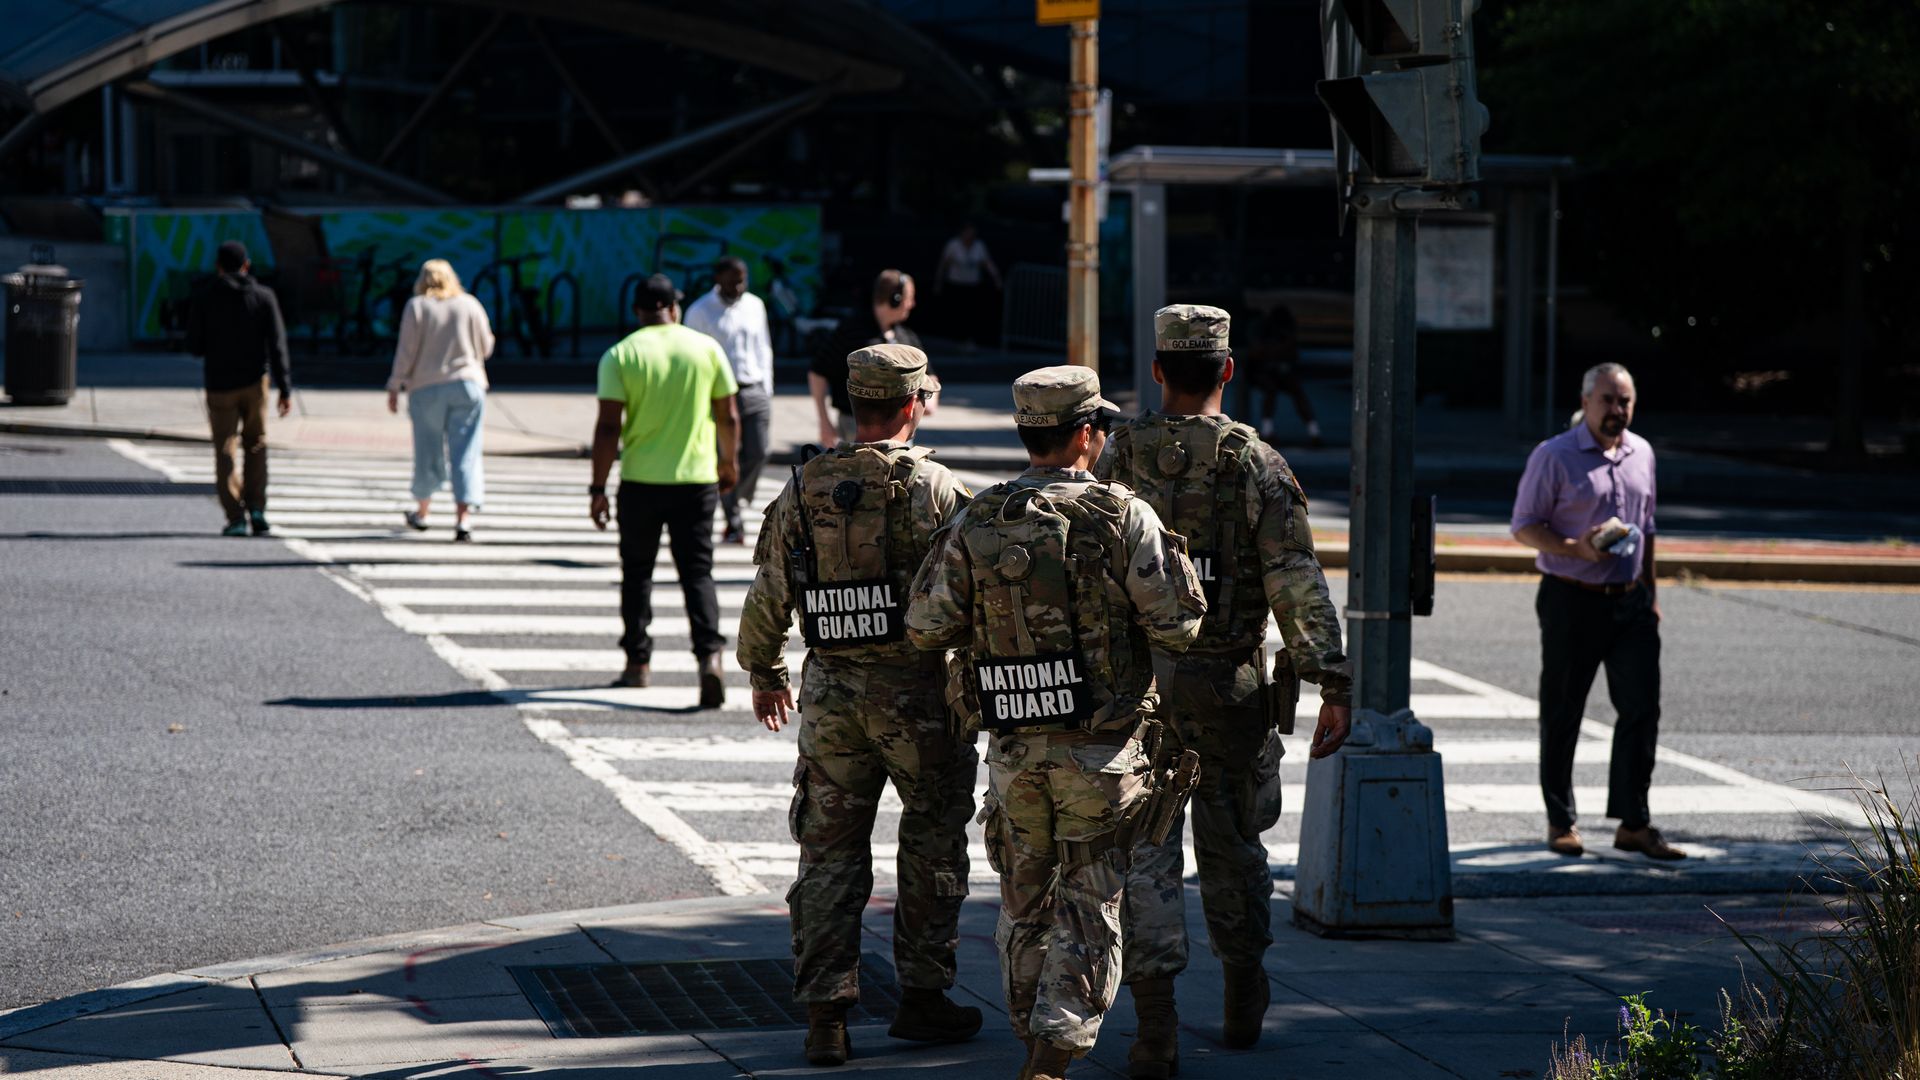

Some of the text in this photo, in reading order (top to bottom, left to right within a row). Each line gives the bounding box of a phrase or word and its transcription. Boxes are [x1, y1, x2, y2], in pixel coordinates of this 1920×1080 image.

[805, 584, 898, 614] NATIONAL
[817, 612, 888, 640] GUARD
[978, 658, 1083, 691] NATIONAL
[994, 688, 1075, 720] GUARD
